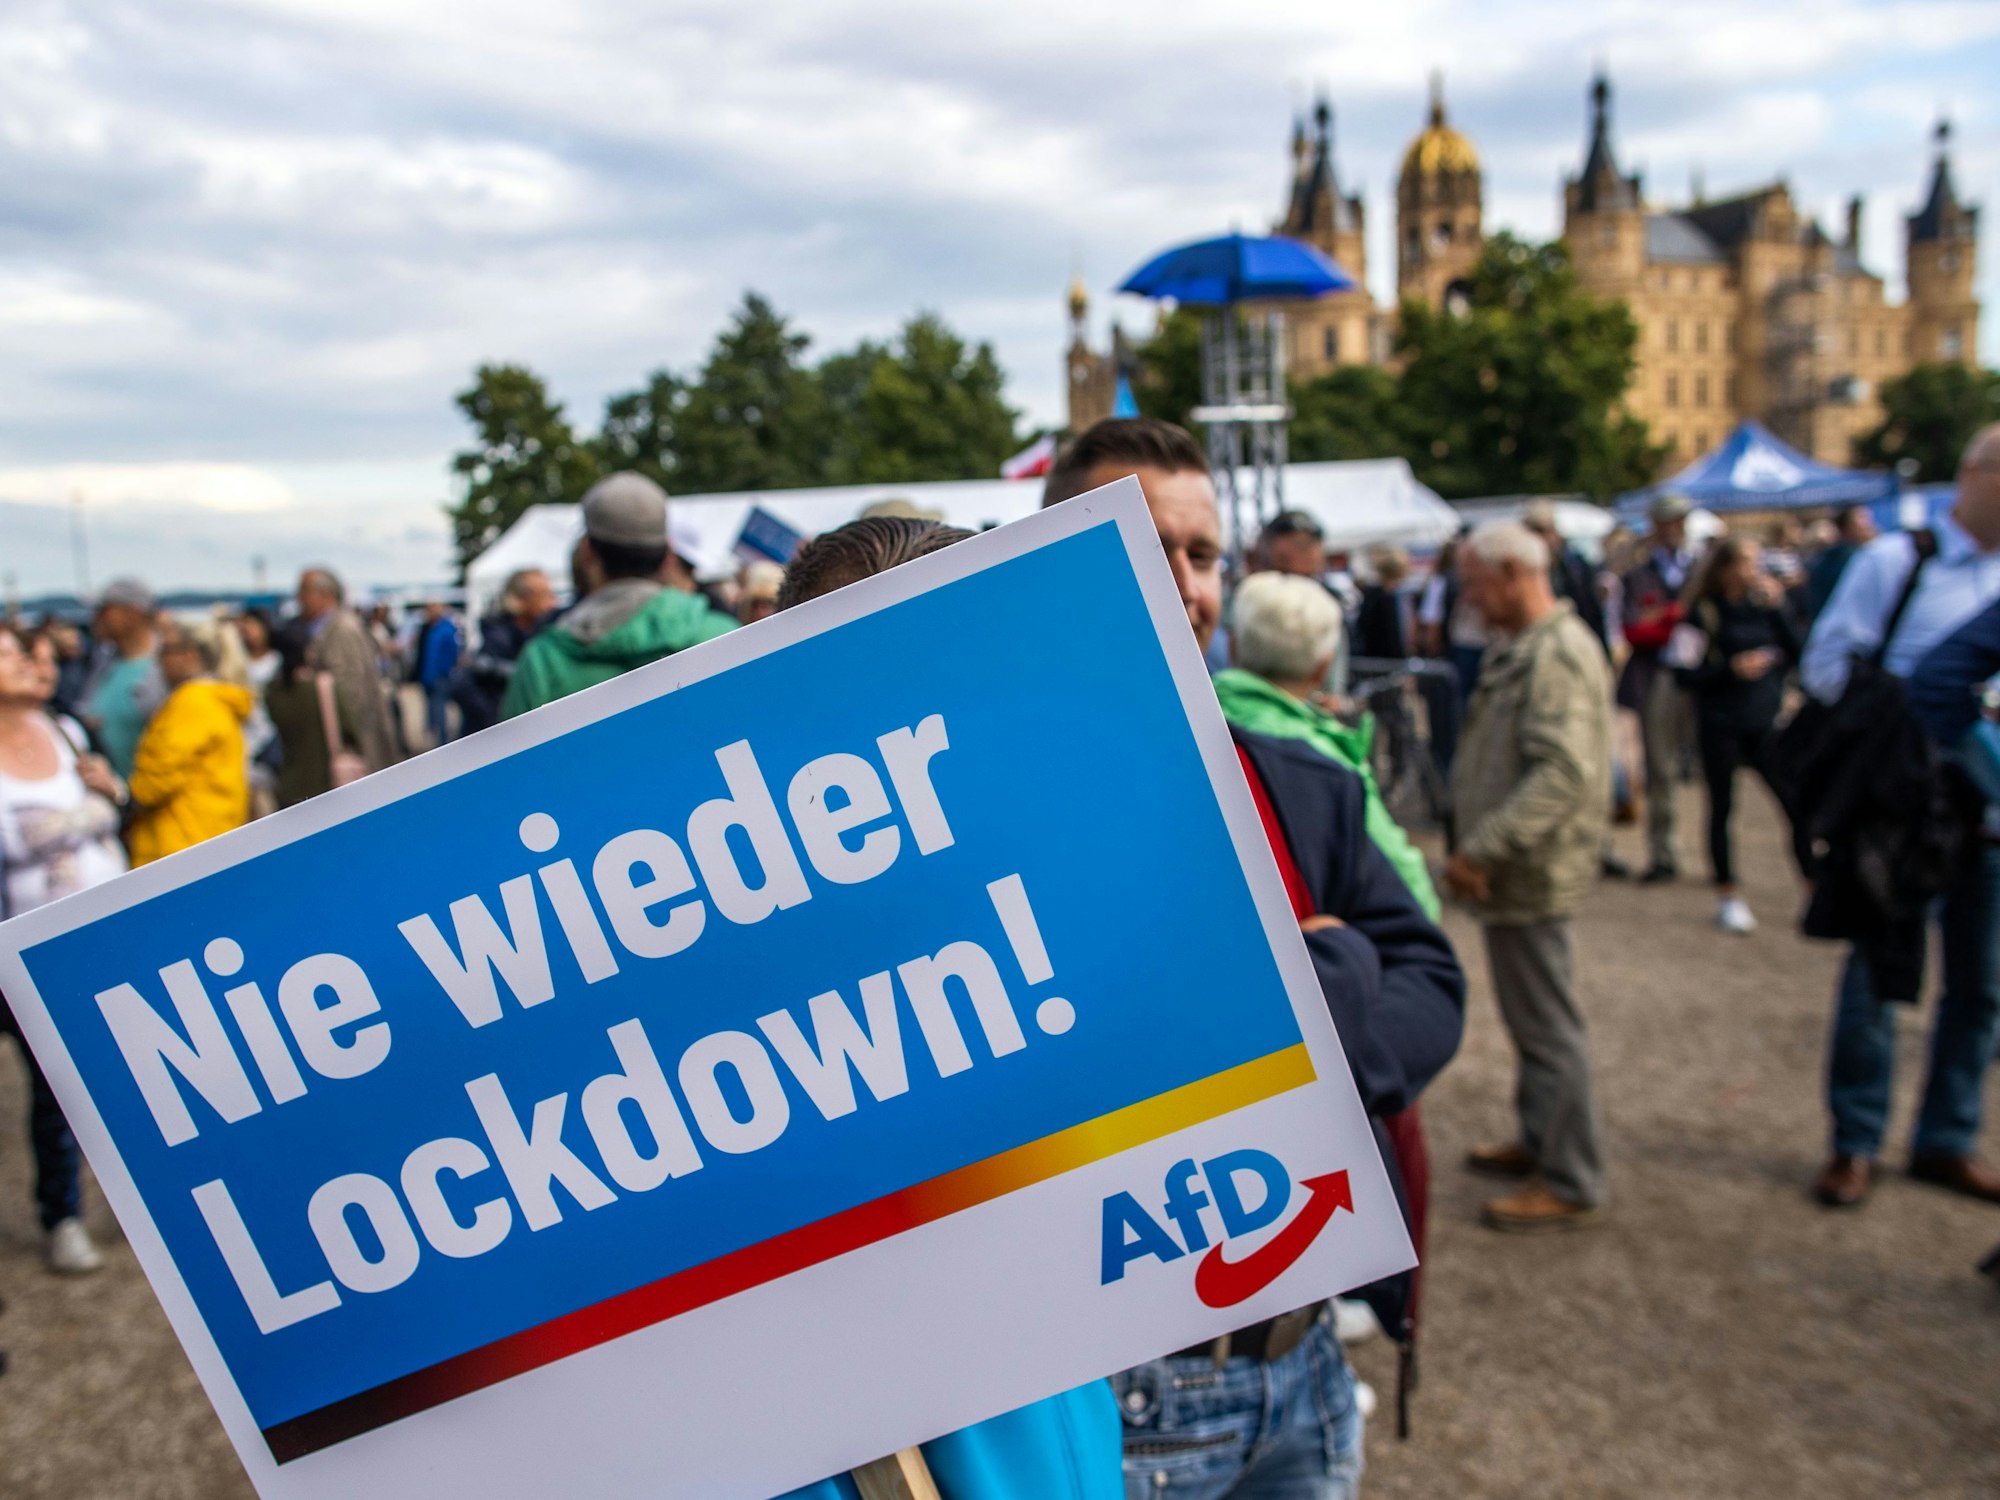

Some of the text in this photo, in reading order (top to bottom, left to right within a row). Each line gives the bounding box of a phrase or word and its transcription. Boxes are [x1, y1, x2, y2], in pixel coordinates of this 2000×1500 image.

[95, 714, 954, 1146] Nie wieder
[191, 873, 1076, 1334] Lockdown!
[1101, 1149, 1291, 1286] AfD
